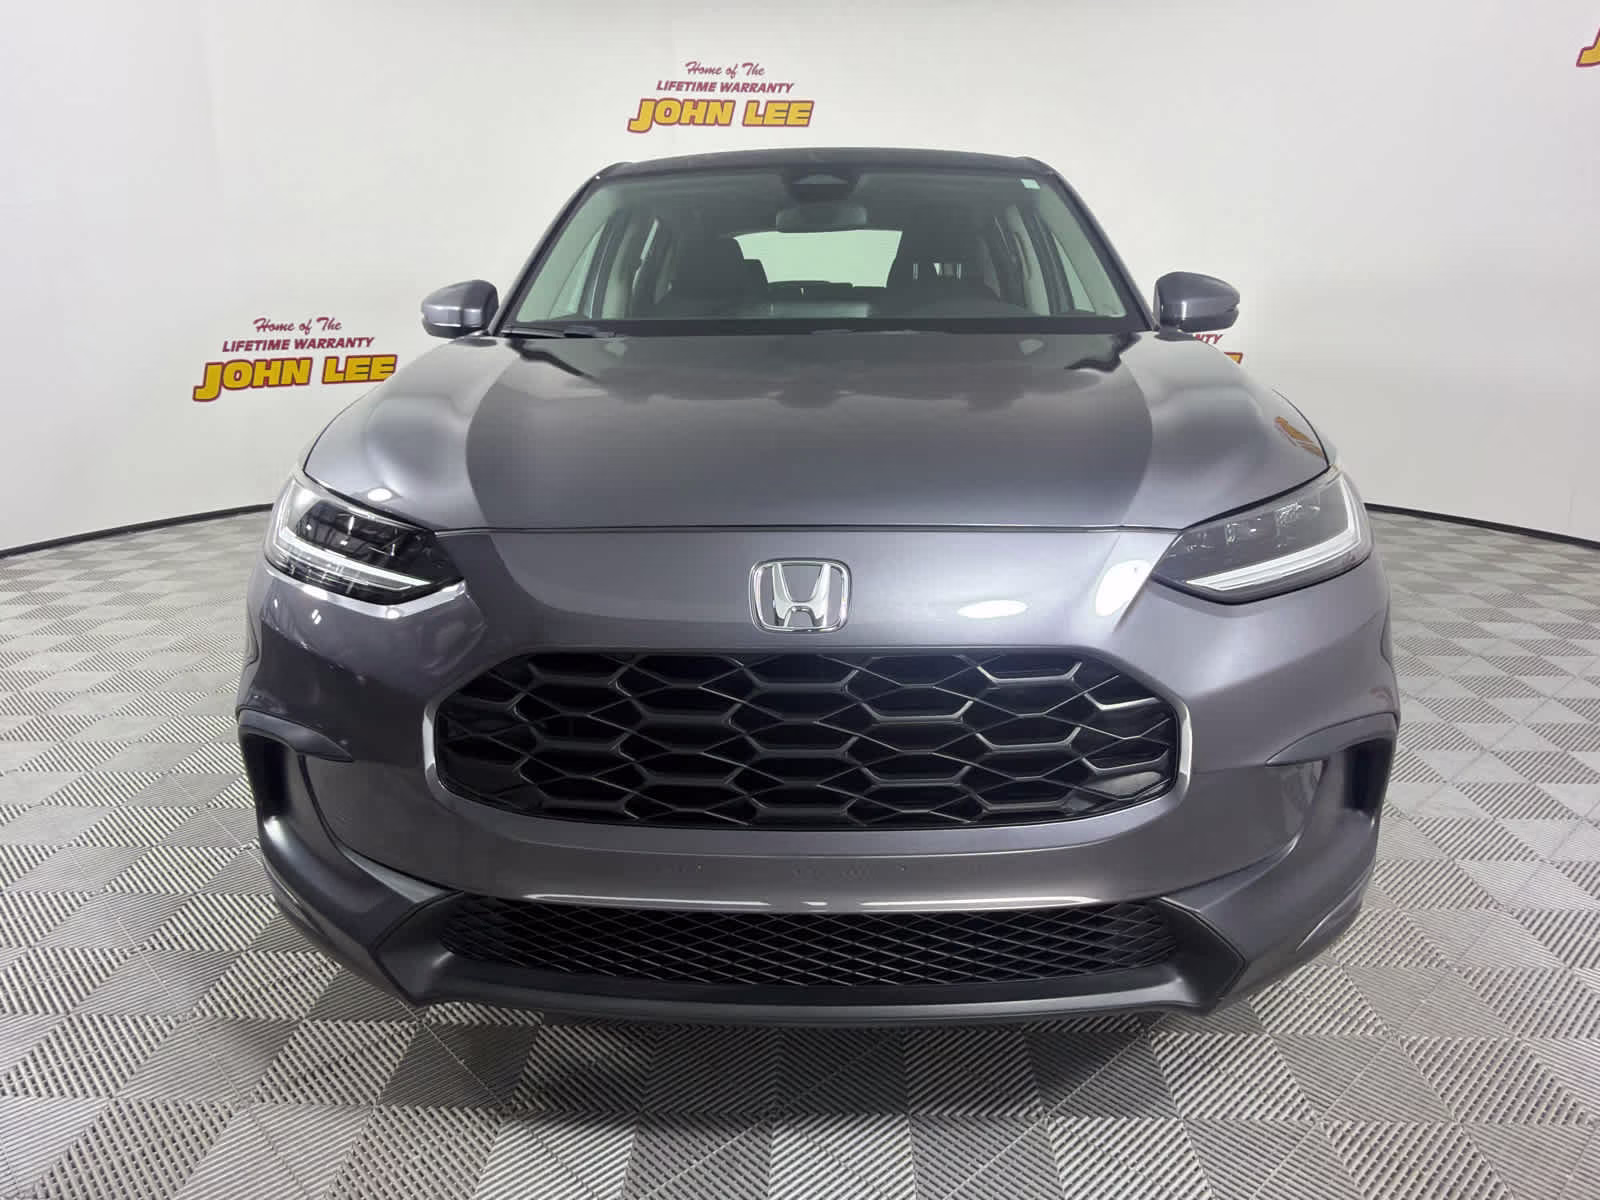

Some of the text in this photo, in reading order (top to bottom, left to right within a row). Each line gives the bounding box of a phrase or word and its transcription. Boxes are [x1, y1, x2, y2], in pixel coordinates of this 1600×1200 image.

[685, 61, 766, 79] Home of The
[656, 80, 794, 93] LIFETIME WARRANTY
[627, 97, 815, 134] JOHN LEE
[253, 316, 342, 335] Home of The
[222, 337, 375, 353] LIFETIME WARRANTY
[192, 354, 398, 402] JOHN LEE
